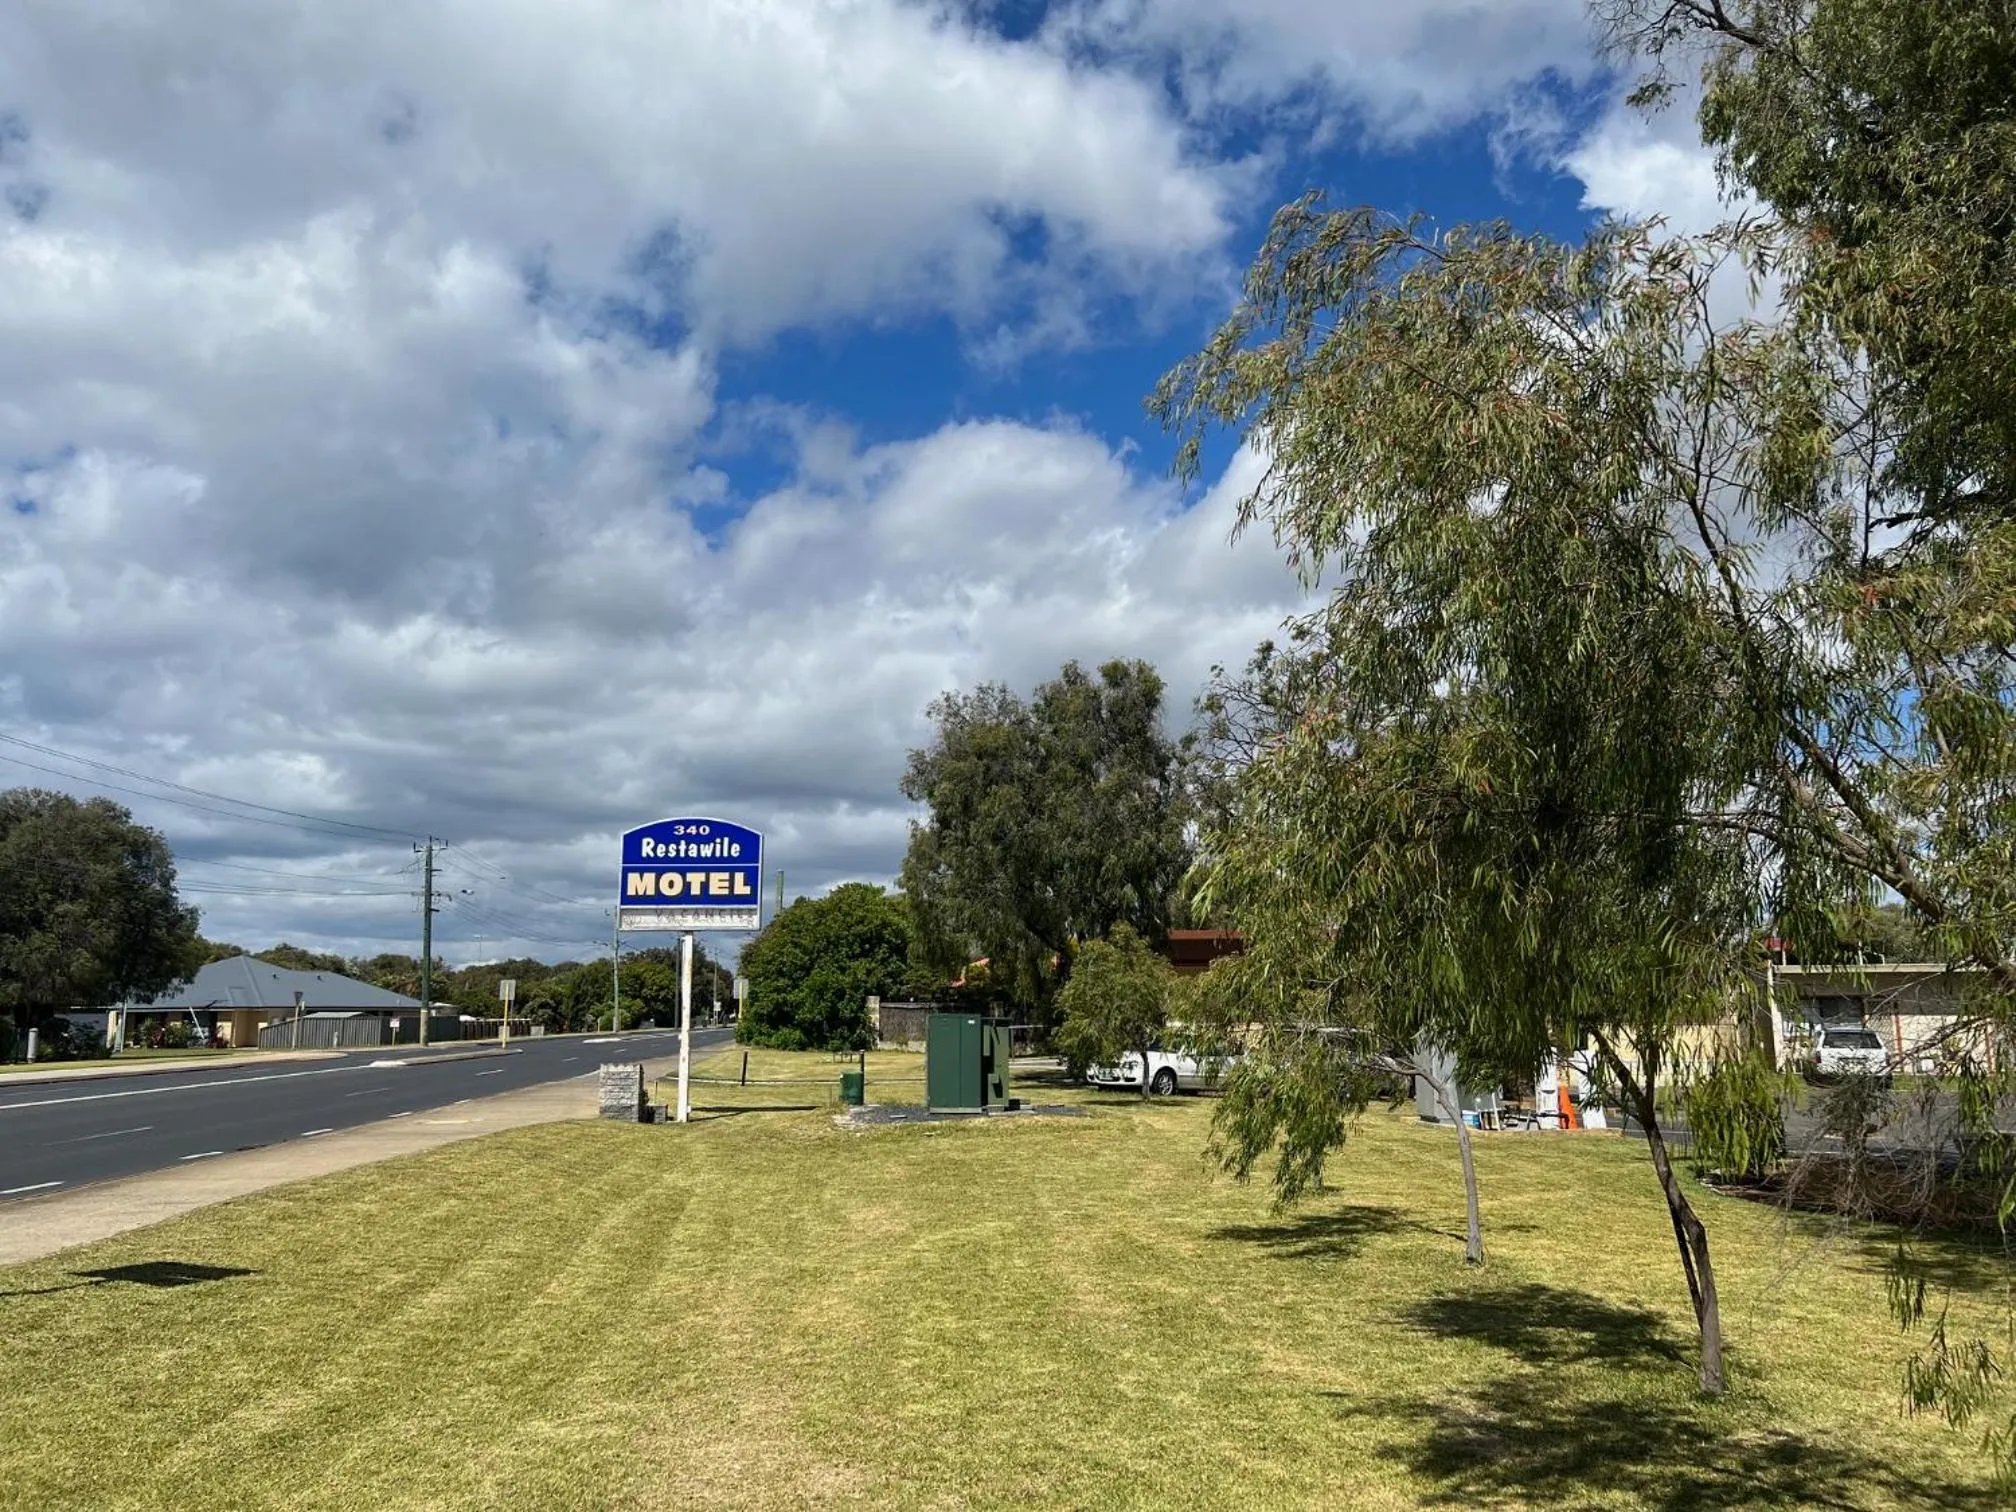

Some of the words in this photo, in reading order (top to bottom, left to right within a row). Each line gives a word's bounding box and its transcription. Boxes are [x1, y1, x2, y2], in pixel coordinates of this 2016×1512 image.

[673, 825, 710, 835] 340
[641, 837, 740, 857] Restawile
[627, 872, 751, 896] MOTEL
